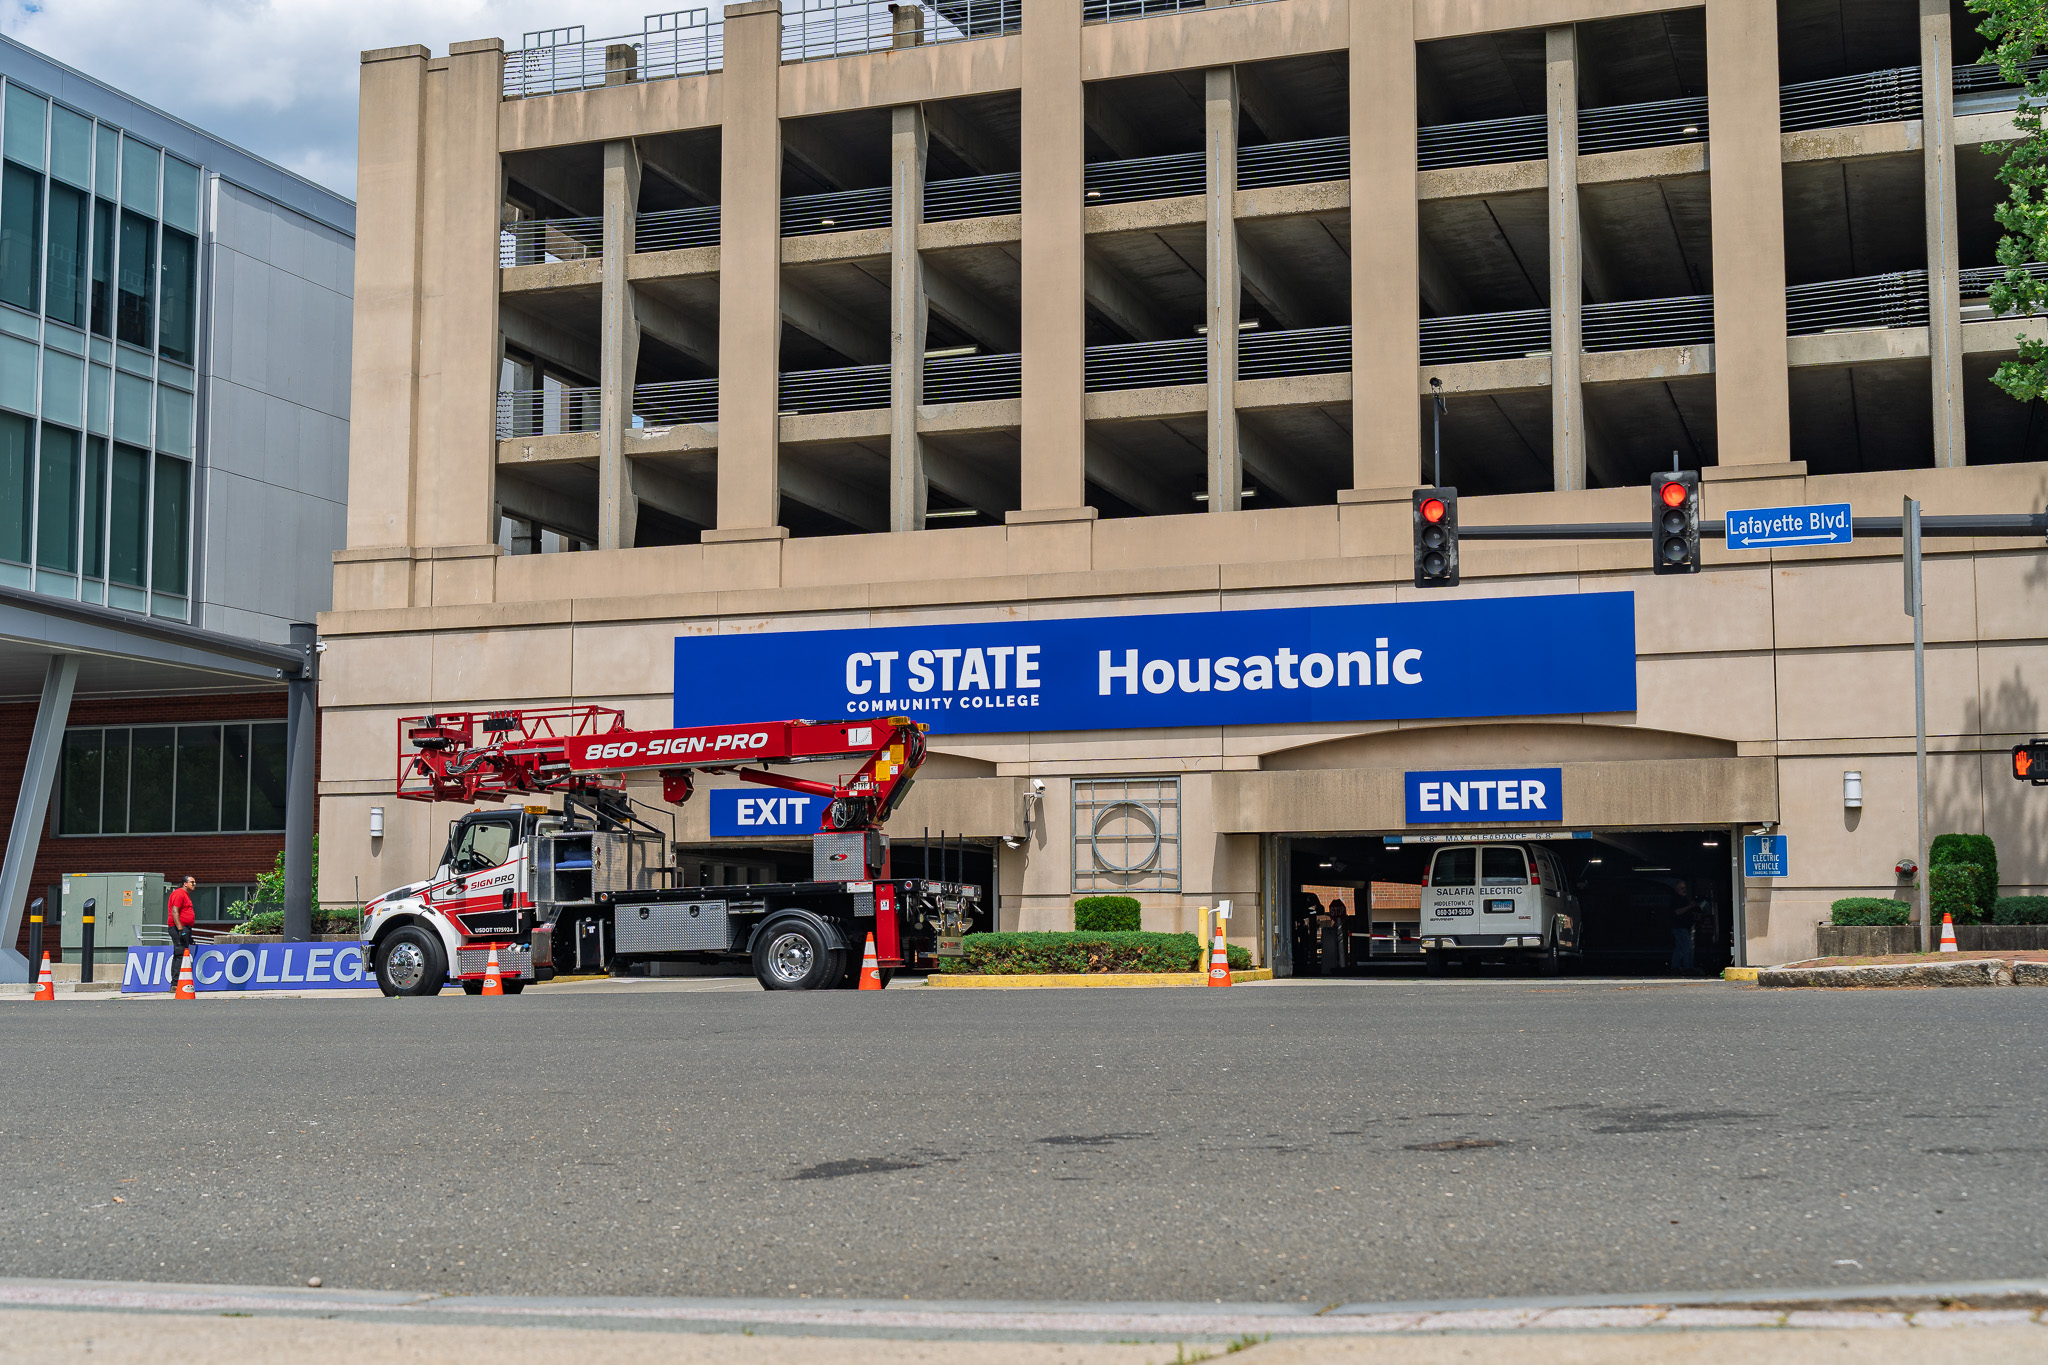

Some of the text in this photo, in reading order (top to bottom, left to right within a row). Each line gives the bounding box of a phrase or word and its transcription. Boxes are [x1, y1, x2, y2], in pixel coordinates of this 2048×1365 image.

[1729, 510, 1849, 537] Lafayette Blvd.
[845, 645, 1041, 695] CT STATE
[1098, 637, 1423, 696] Housatonic
[846, 694, 1040, 713] COMMUNITY COLLEGE
[584, 732, 769, 761] 860-SIGN-PRO
[1419, 780, 1547, 811] ENTER
[737, 797, 810, 825] EXIT
[1470, 833, 1527, 841] CLEARANCE
[1752, 854, 1780, 862] ELECTRIC
[1754, 862, 1779, 870] VEHICLE
[470, 873, 515, 889] SIGN PRO
[1436, 887, 1523, 896] SALAFIA ELECTRIC
